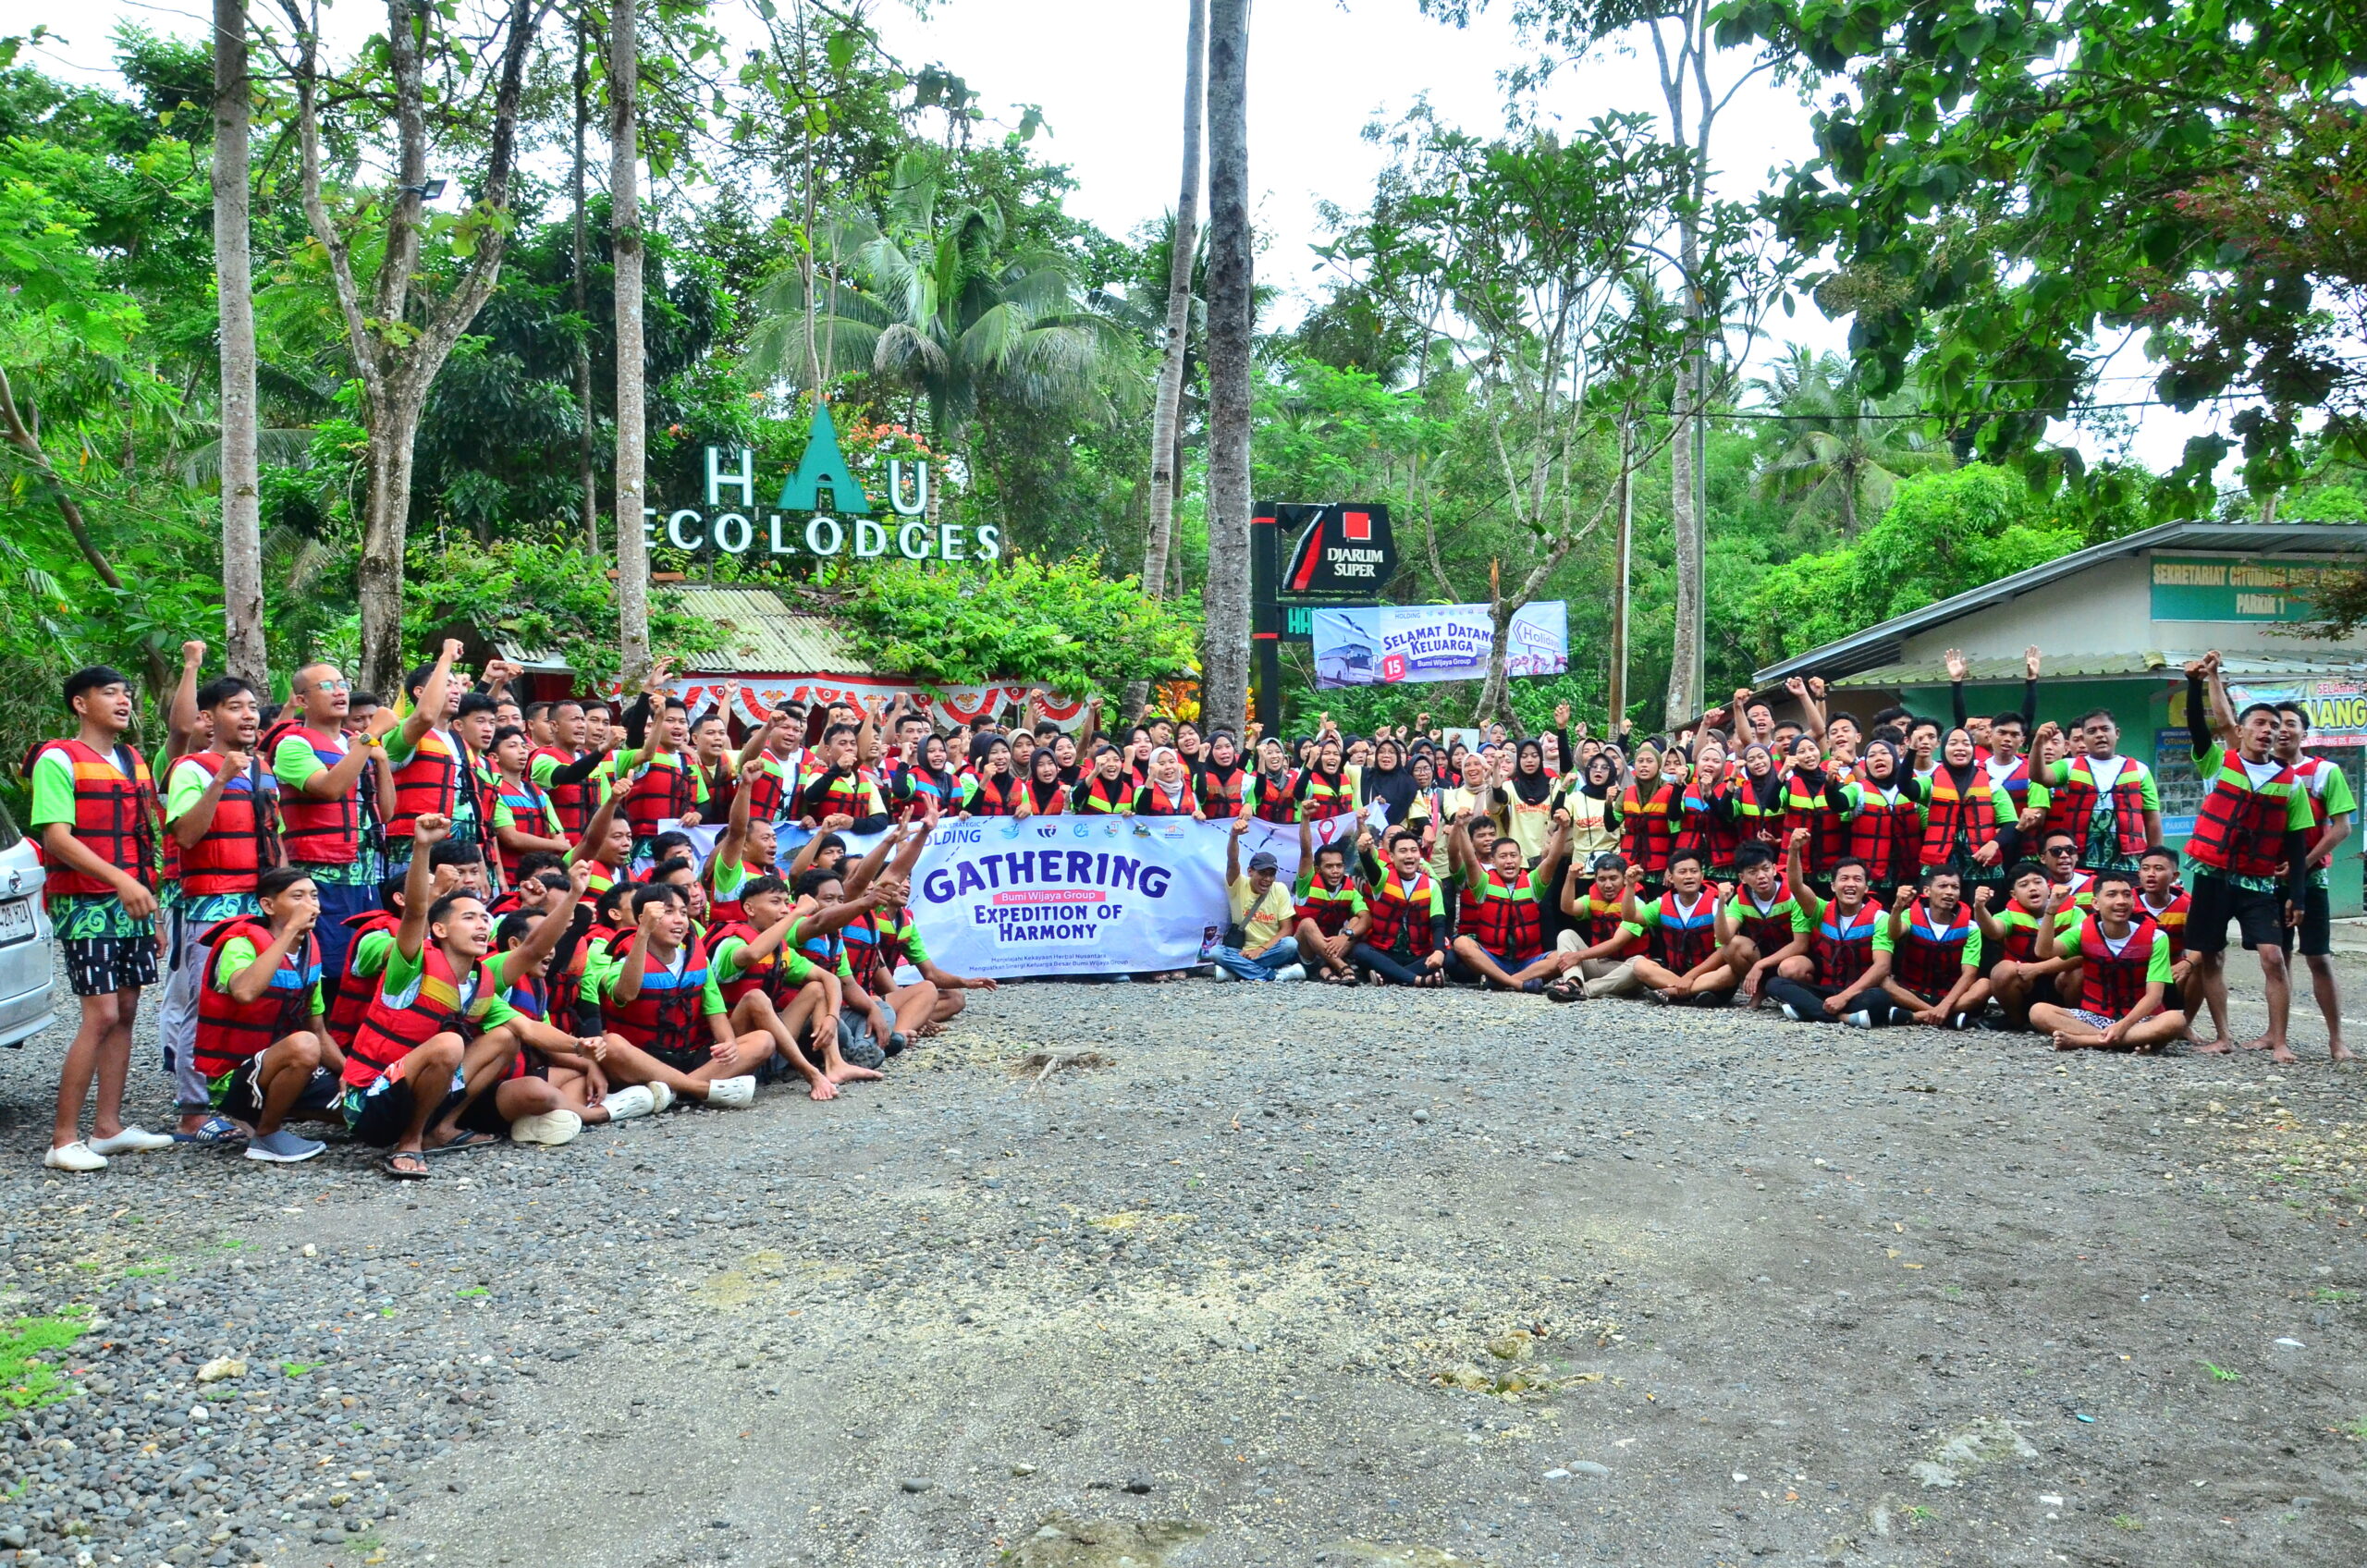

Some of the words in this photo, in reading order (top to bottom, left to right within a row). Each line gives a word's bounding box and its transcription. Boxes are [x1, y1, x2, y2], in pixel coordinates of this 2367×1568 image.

[705, 404, 927, 516] HAU
[644, 508, 1000, 560] ECOLODGES
[1327, 547, 1383, 562] DJARUM
[1334, 563, 1376, 577] SUPER
[2152, 564, 2226, 586] SEKRETARIAT
[2236, 594, 2276, 614] PARKIR
[1288, 607, 1324, 634] HA
[1383, 626, 1441, 651] SELAMAT
[1410, 639, 1474, 655] KELUARGA
[1387, 659, 1402, 675] 15
[1417, 659, 1433, 668] Bumi
[1433, 659, 1453, 668] Wijaya
[1453, 657, 1472, 666] Group
[2300, 696, 2367, 729] NANG
[949, 821, 981, 829] STRATEGIC
[924, 829, 982, 847] OLDING
[923, 850, 1172, 904] GATHERING
[1001, 893, 1026, 902] Bumi
[1028, 891, 1061, 902] Wijaya
[1063, 891, 1096, 902] Group
[975, 905, 1088, 925] EXPEDITION
[1097, 904, 1123, 920] OF
[1000, 923, 1098, 942] HARMONY
[1026, 961, 1053, 969] Keluarga
[1089, 958, 1110, 967] Wijaya
[1110, 958, 1129, 966] Group
